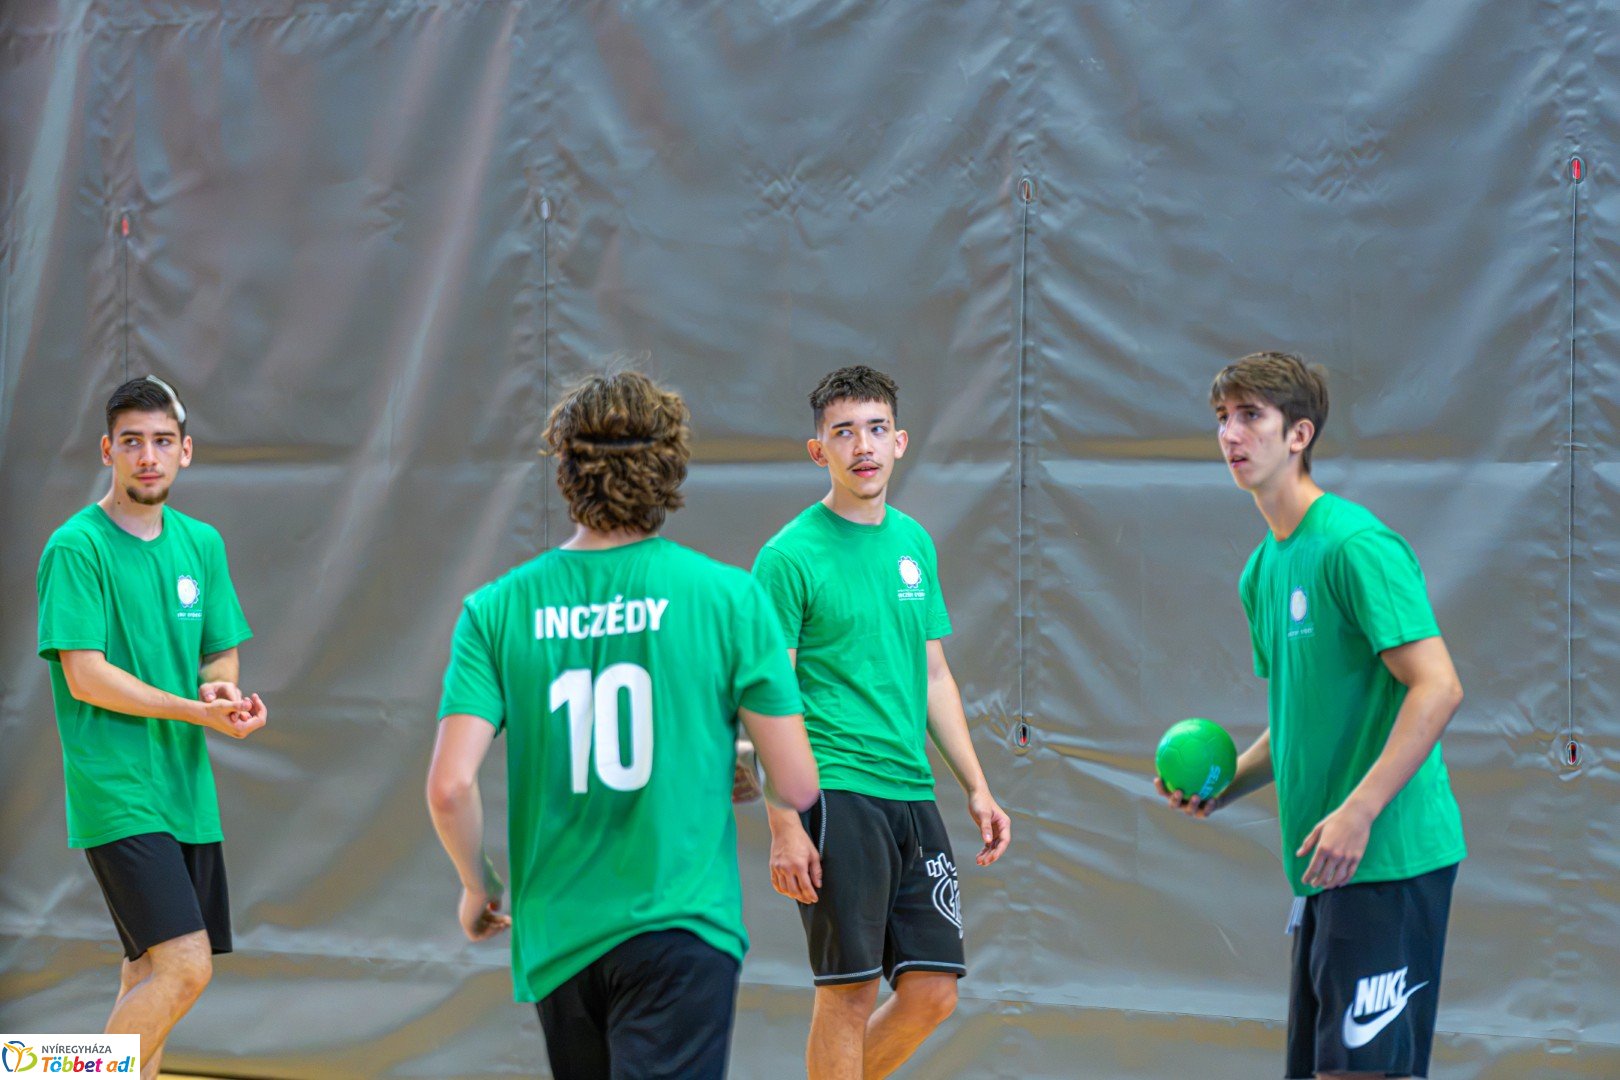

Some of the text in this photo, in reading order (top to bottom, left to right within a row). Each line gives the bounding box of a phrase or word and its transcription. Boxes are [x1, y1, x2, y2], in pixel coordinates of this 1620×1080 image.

[534, 595, 669, 639] INCZÉDY
[549, 663, 653, 794] 10
[1353, 966, 1408, 1017] NIKE
